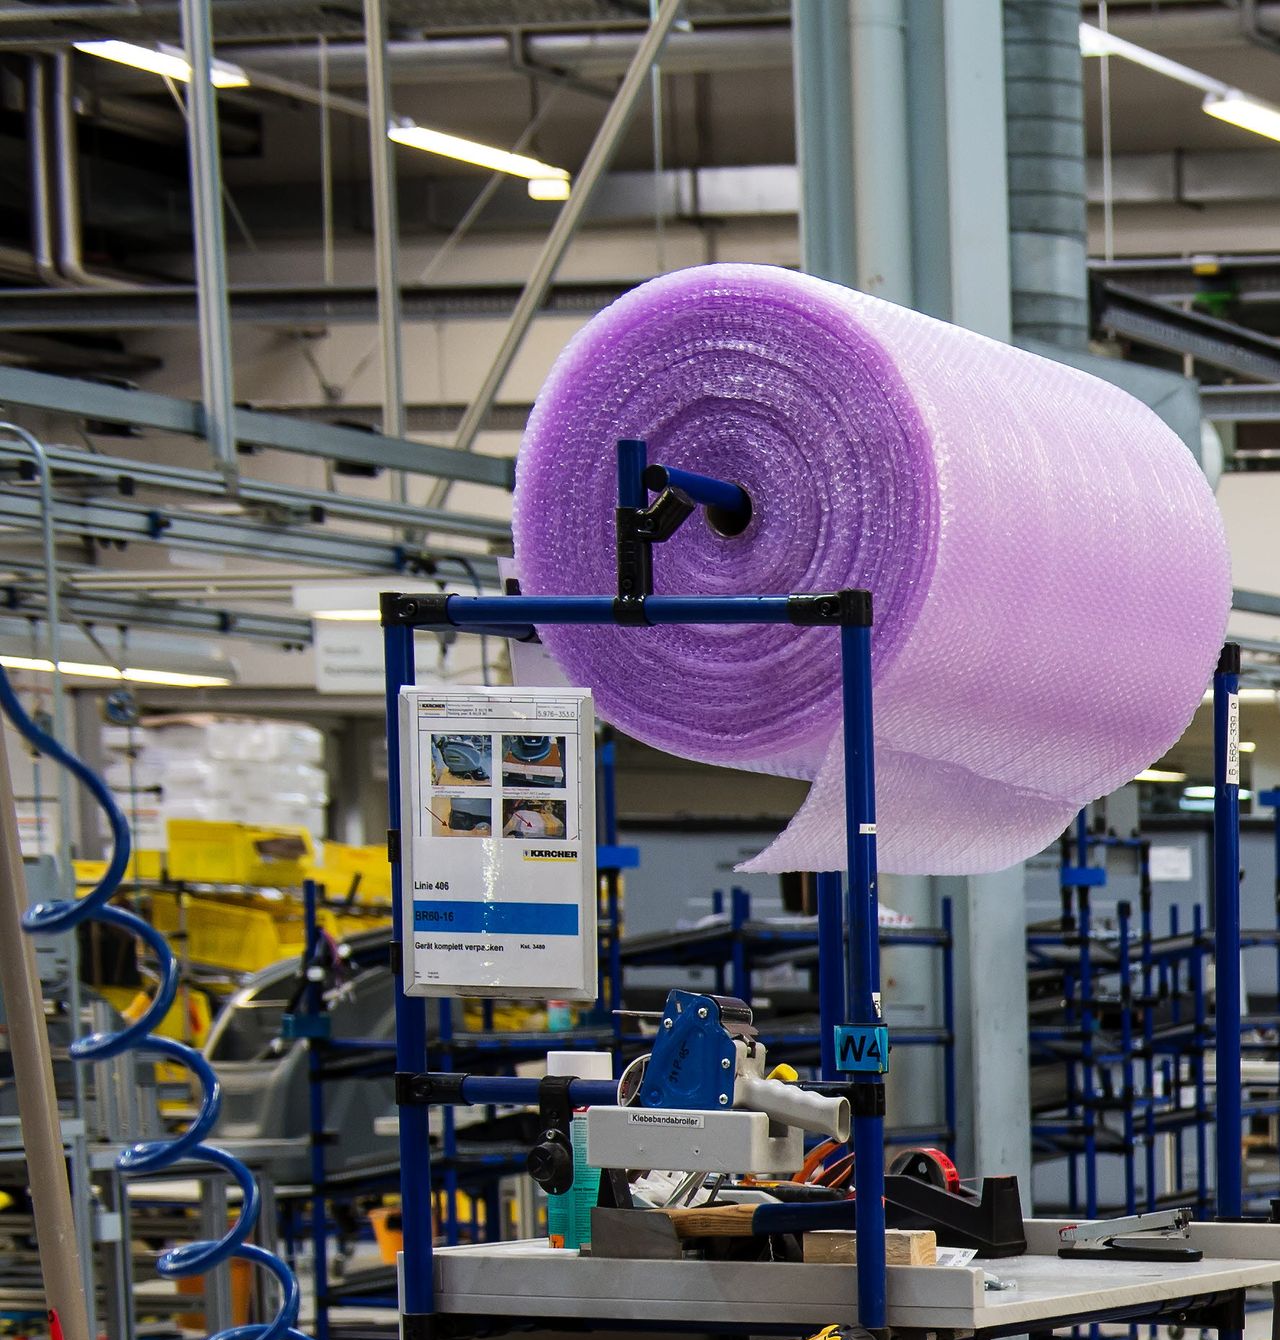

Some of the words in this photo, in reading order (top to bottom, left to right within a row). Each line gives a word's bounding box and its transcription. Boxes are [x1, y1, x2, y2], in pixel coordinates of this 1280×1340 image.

[530, 849, 578, 858] KÄRCHER
[414, 881, 433, 890] Linie
[414, 941, 433, 950] Gerät
[434, 943, 463, 952] komplett
